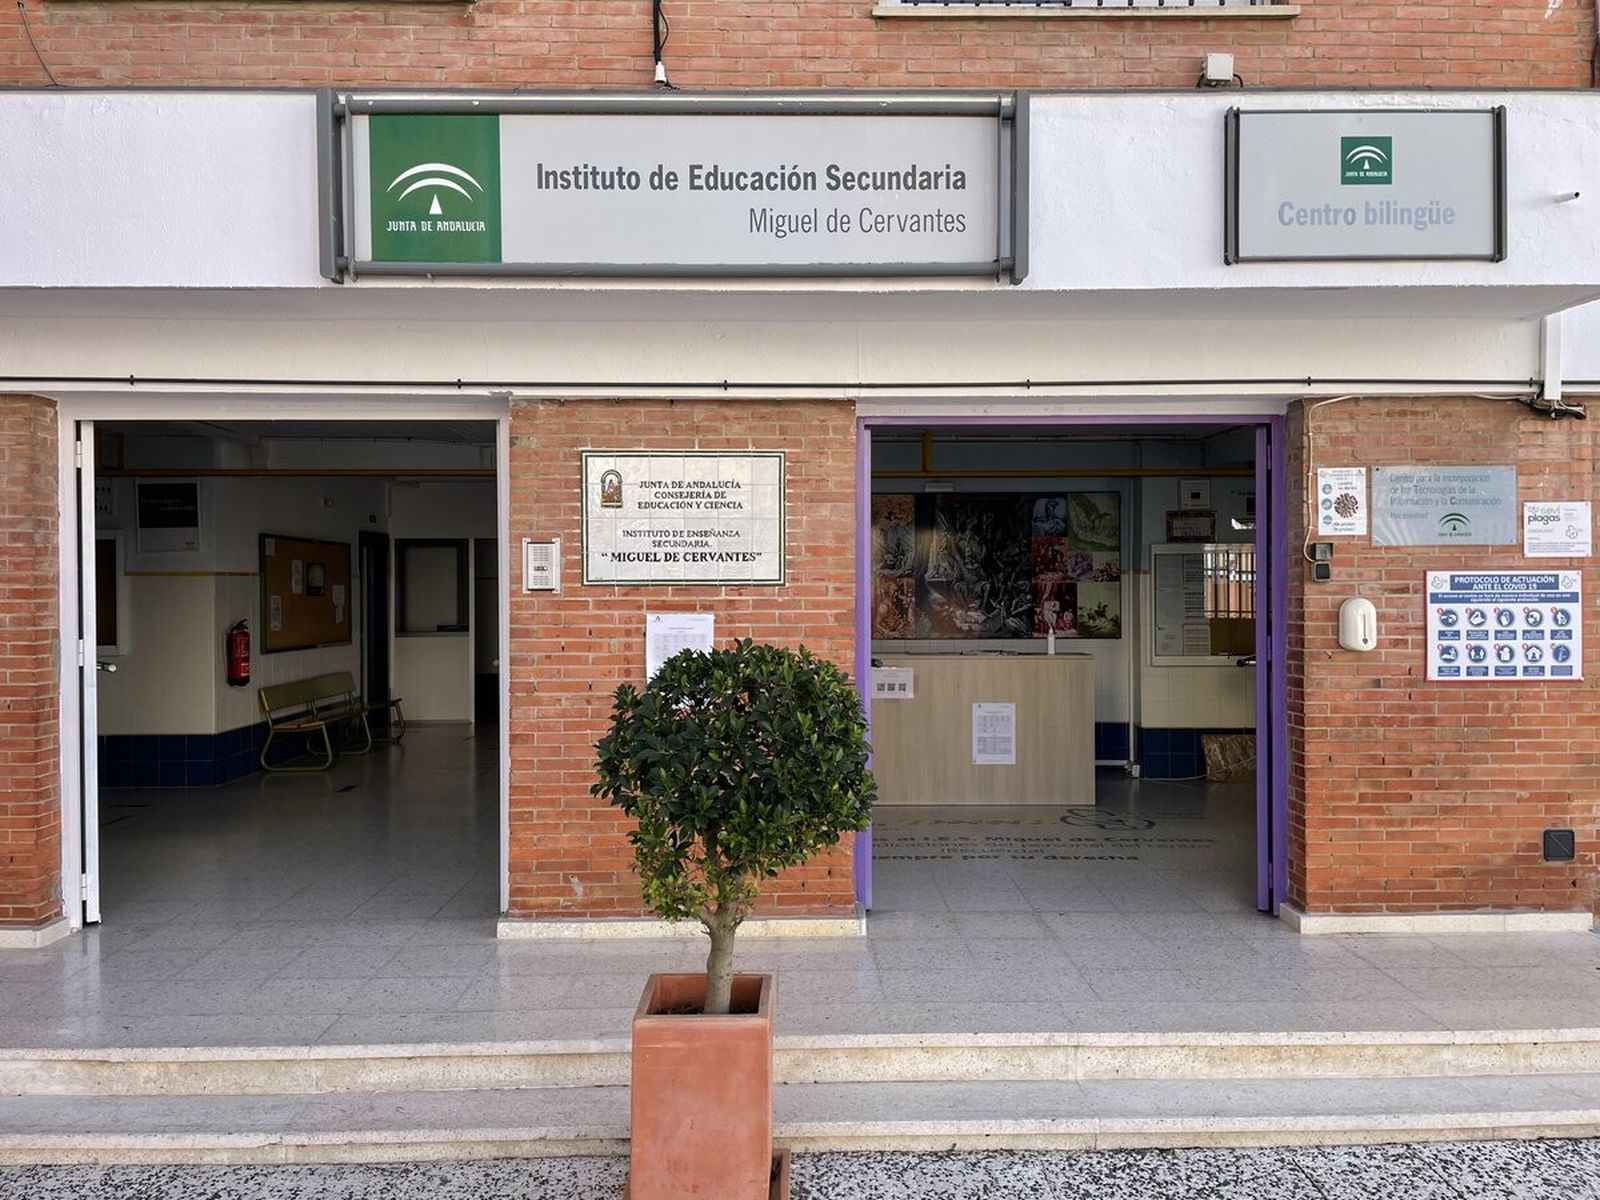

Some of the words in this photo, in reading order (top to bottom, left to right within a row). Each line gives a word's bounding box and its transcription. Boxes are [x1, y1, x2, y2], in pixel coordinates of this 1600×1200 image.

[536, 163, 641, 191] Instituto
[649, 163, 679, 191] de
[688, 163, 817, 191] Educación
[825, 163, 967, 191] Secundaria
[1277, 201, 1356, 227] Centro
[1364, 200, 1455, 230] bilingüe
[386, 220, 417, 232] JUNTA
[421, 220, 433, 232] DE
[749, 207, 818, 238] Miguel
[826, 207, 850, 233] de
[859, 207, 967, 233] Cervantes
[639, 480, 669, 489] JUNTA
[671, 481, 684, 489] DE
[686, 478, 741, 489] ANDALUCÍA
[654, 490, 712, 500] CONSEJERÍA
[714, 491, 727, 499] DE
[637, 499, 694, 510] EDUCACIÓN
[696, 501, 703, 509] Y
[704, 501, 743, 510] CIENCIA
[1528, 513, 1560, 525] plagas
[622, 530, 670, 538] INSTITUTO
[672, 530, 684, 538] DE
[686, 528, 741, 538] ENSEÑANZA
[610, 552, 661, 563] MIGUEL
[663, 552, 680, 563] DE
[1454, 576, 1499, 584] PROTOCOLO
[1512, 575, 1555, 583] ACTUACIÓN
